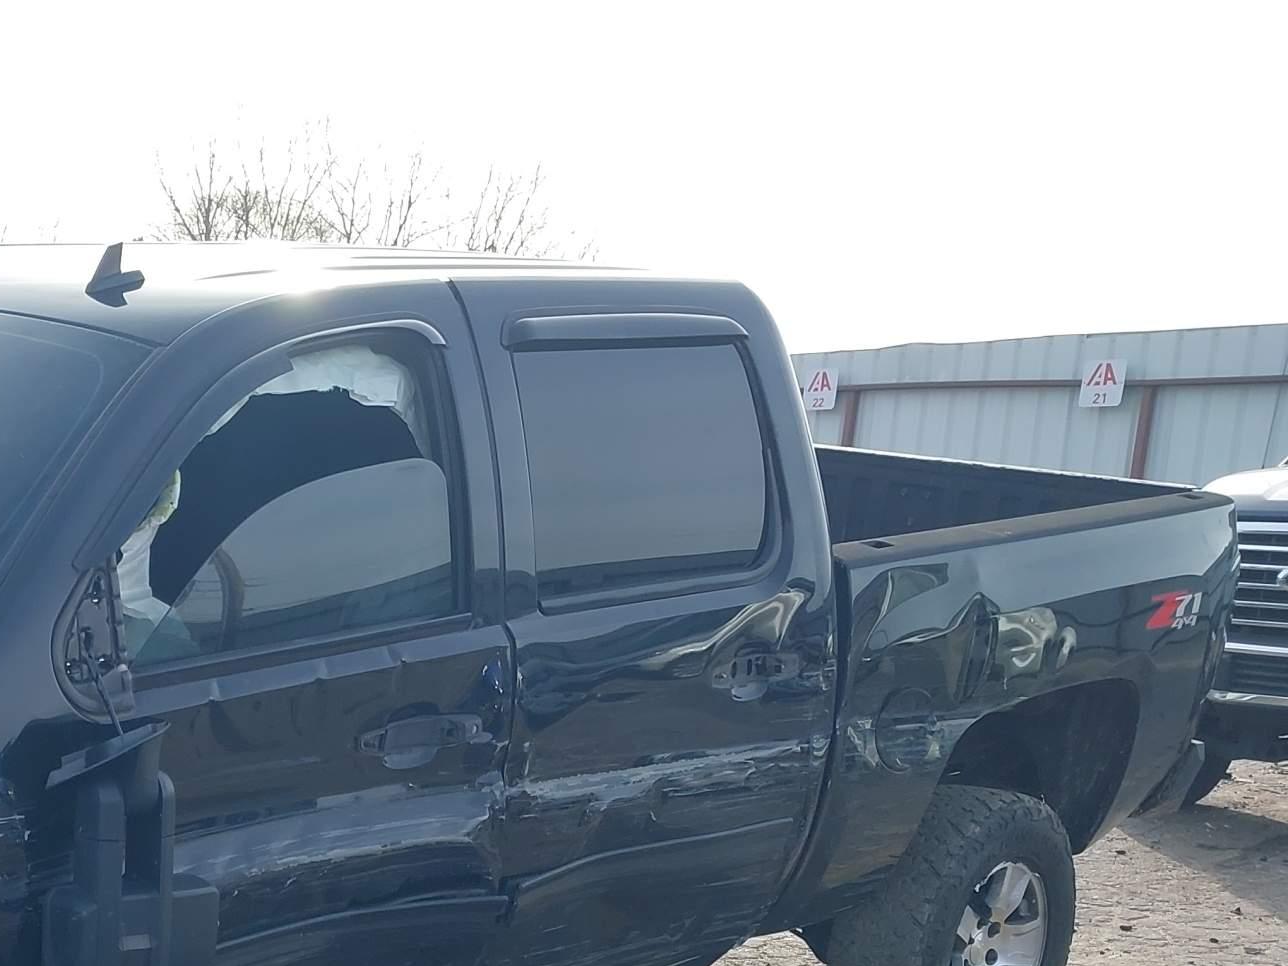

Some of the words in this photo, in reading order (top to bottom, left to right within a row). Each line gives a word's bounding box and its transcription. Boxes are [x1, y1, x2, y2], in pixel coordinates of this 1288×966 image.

[811, 397, 825, 408] 22
[1092, 392, 1107, 405] 21
[1144, 587, 1203, 630] Z71
